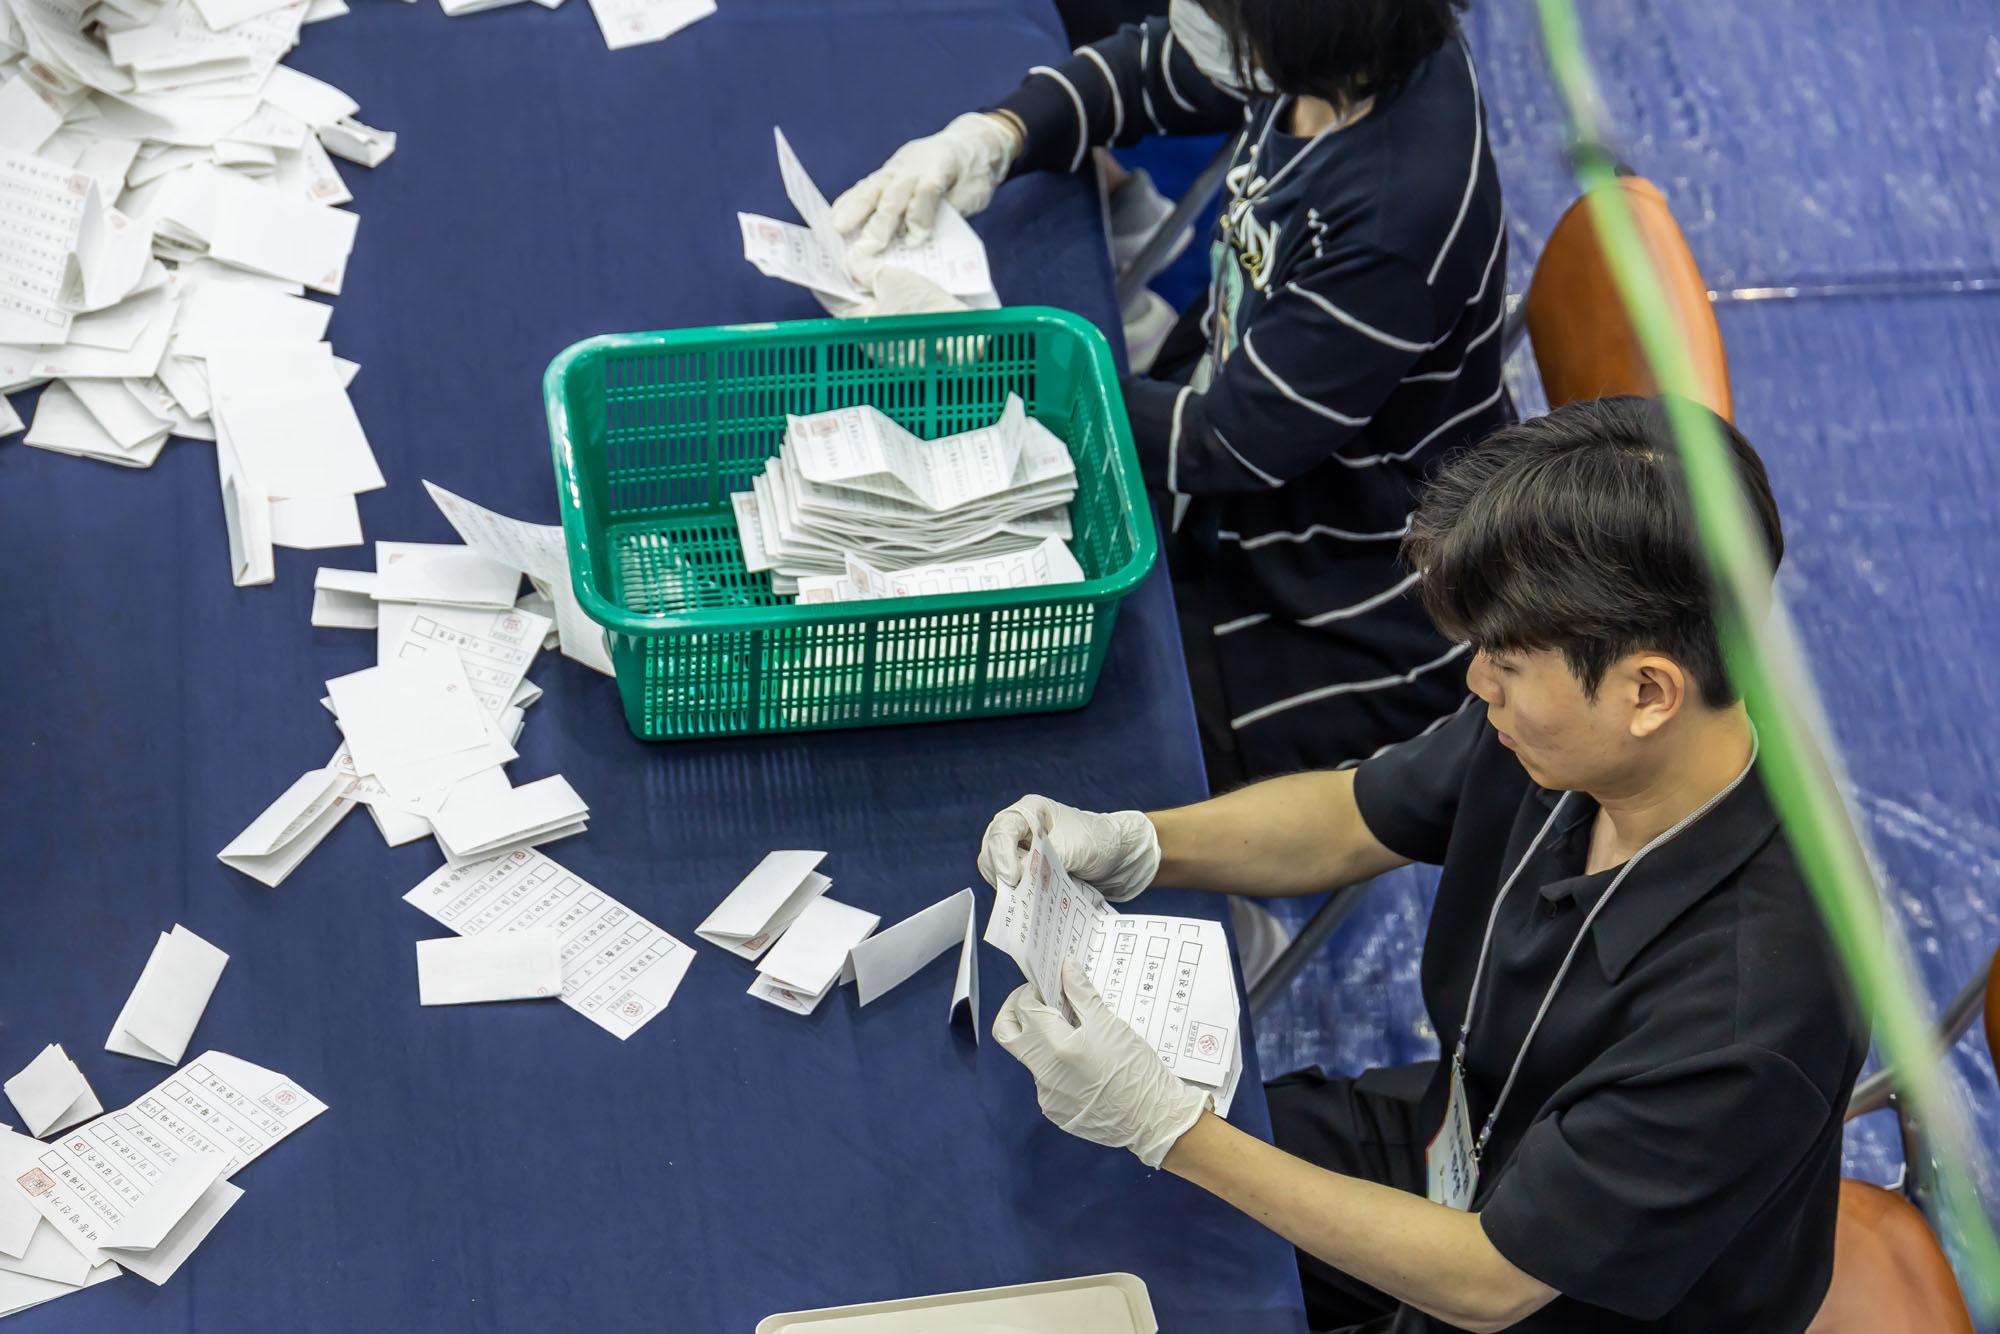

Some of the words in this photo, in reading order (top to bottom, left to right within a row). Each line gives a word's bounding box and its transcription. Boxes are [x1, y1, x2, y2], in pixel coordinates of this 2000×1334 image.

[1085, 955, 1095, 972] 영국
[1111, 958, 1126, 987] 구주와
[1137, 999, 1149, 1024] 소속
[1144, 961, 1158, 991] 황교안
[1176, 969, 1190, 999] 송진호
[209, 1080, 234, 1099] 송진호
[184, 1096, 210, 1116] 황교안
[160, 1115, 185, 1134] 구주와
[111, 1140, 137, 1160] 이준석
[87, 1155, 113, 1176] 김문수
[62, 1169, 86, 1191] 이재명
[113, 1178, 140, 1202] 민의힘
